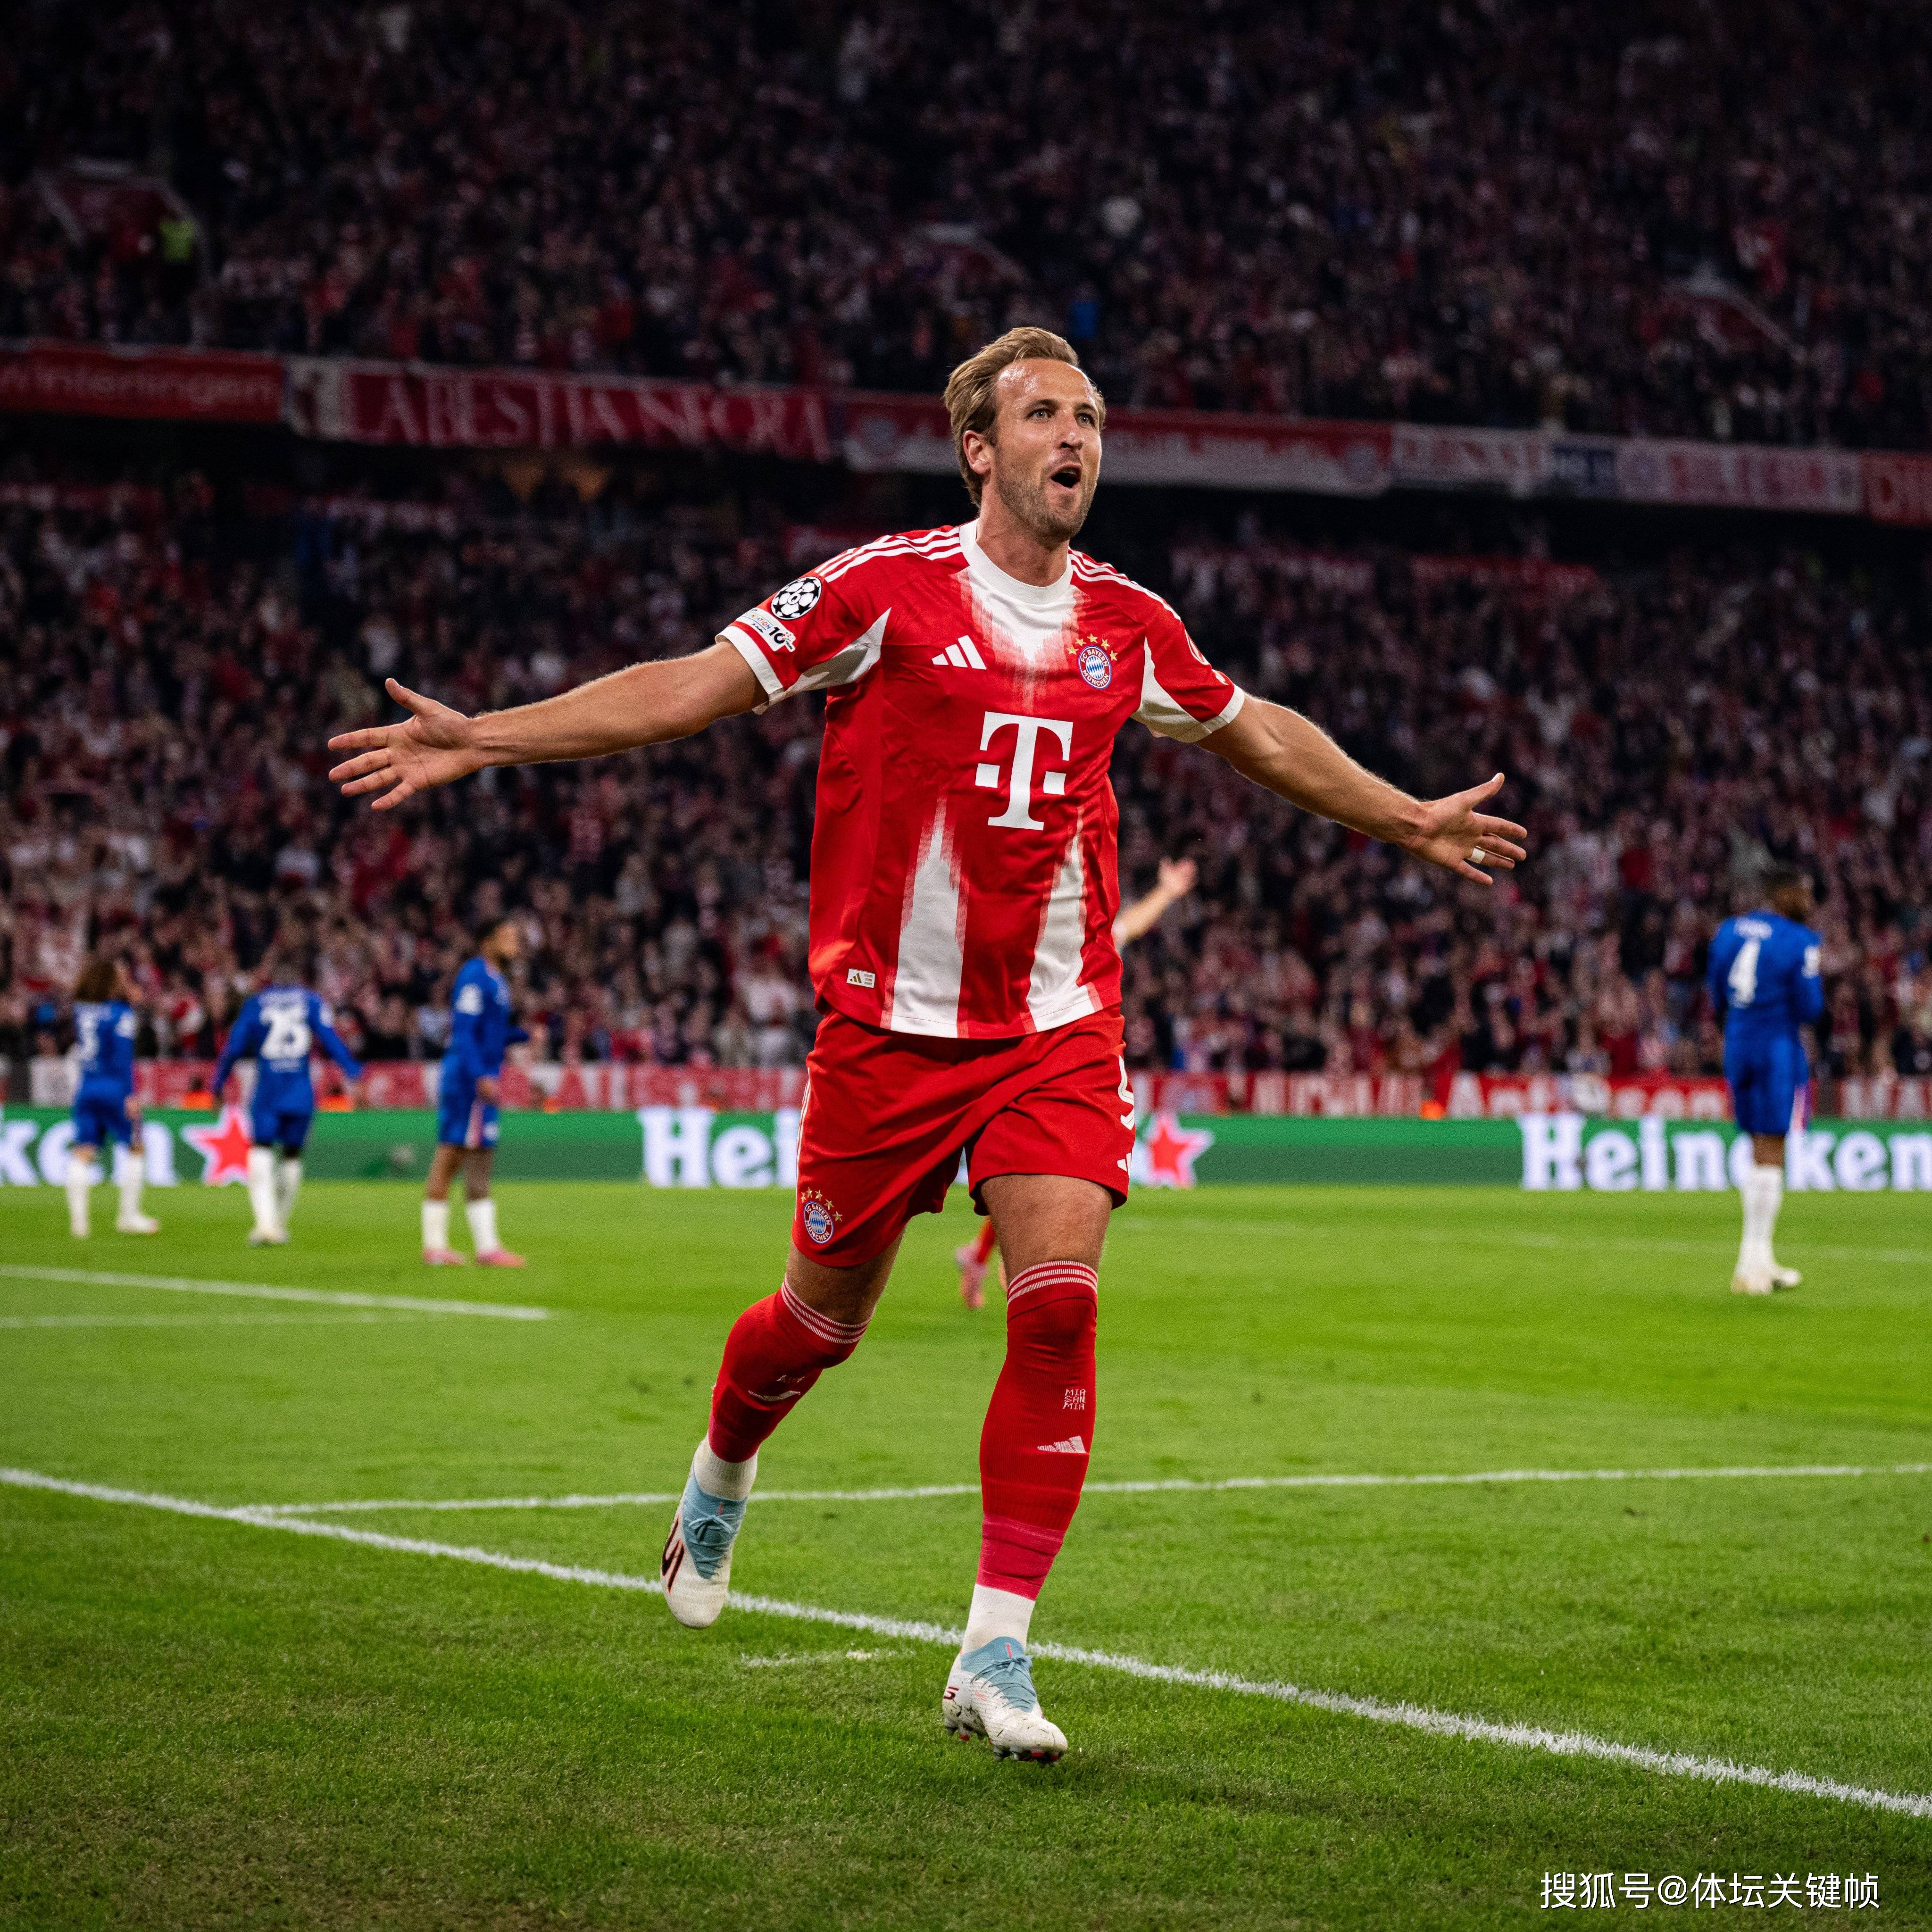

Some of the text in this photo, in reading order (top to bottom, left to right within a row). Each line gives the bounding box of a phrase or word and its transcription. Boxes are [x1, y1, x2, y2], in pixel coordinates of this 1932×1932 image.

[788, 588, 804, 605] 6
[1081, 650, 1109, 667] FC BAYERN
[975, 711, 1073, 831] T
[1726, 940, 1761, 1004] 4
[637, 1107, 801, 1188] Hei
[806, 1204, 831, 1225] FC BAYERN
